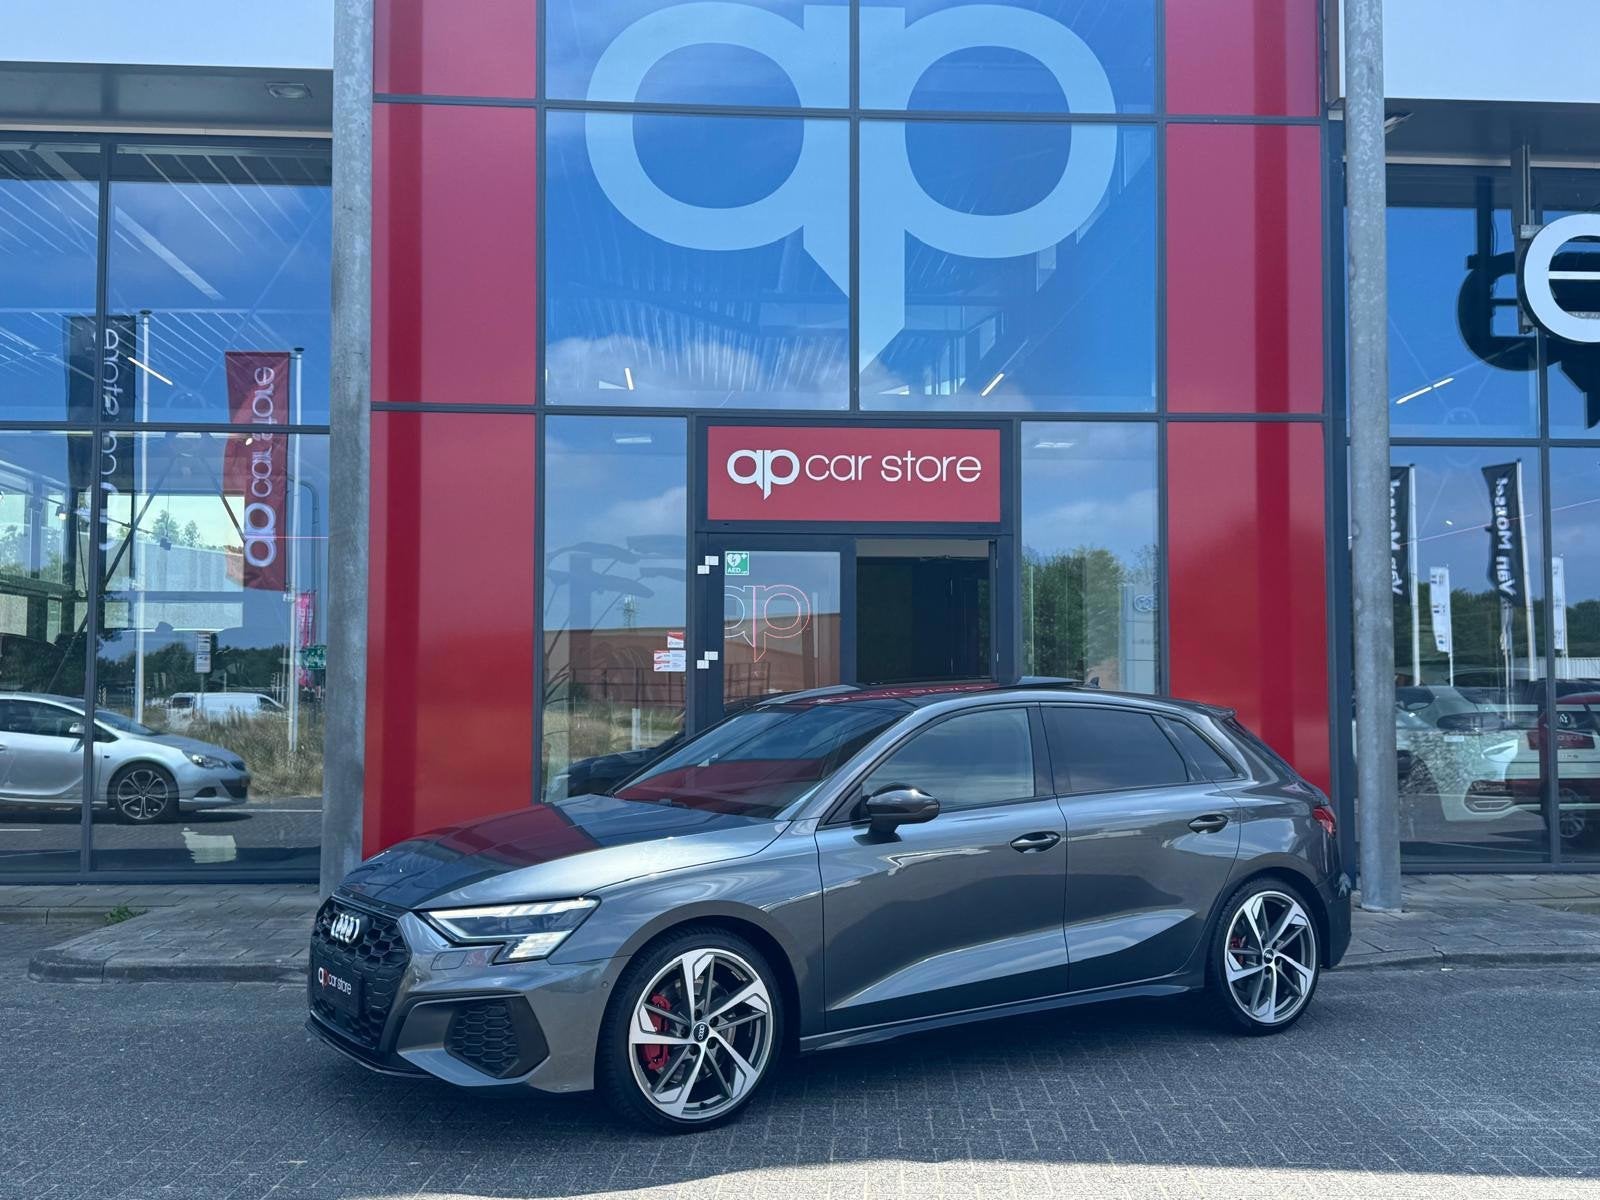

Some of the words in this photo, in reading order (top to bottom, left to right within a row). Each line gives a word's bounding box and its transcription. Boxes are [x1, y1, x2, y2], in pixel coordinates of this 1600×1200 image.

[585, 1, 1117, 376] ap
[727, 449, 801, 501] ap
[805, 454, 872, 482] car
[880, 449, 982, 483] store
